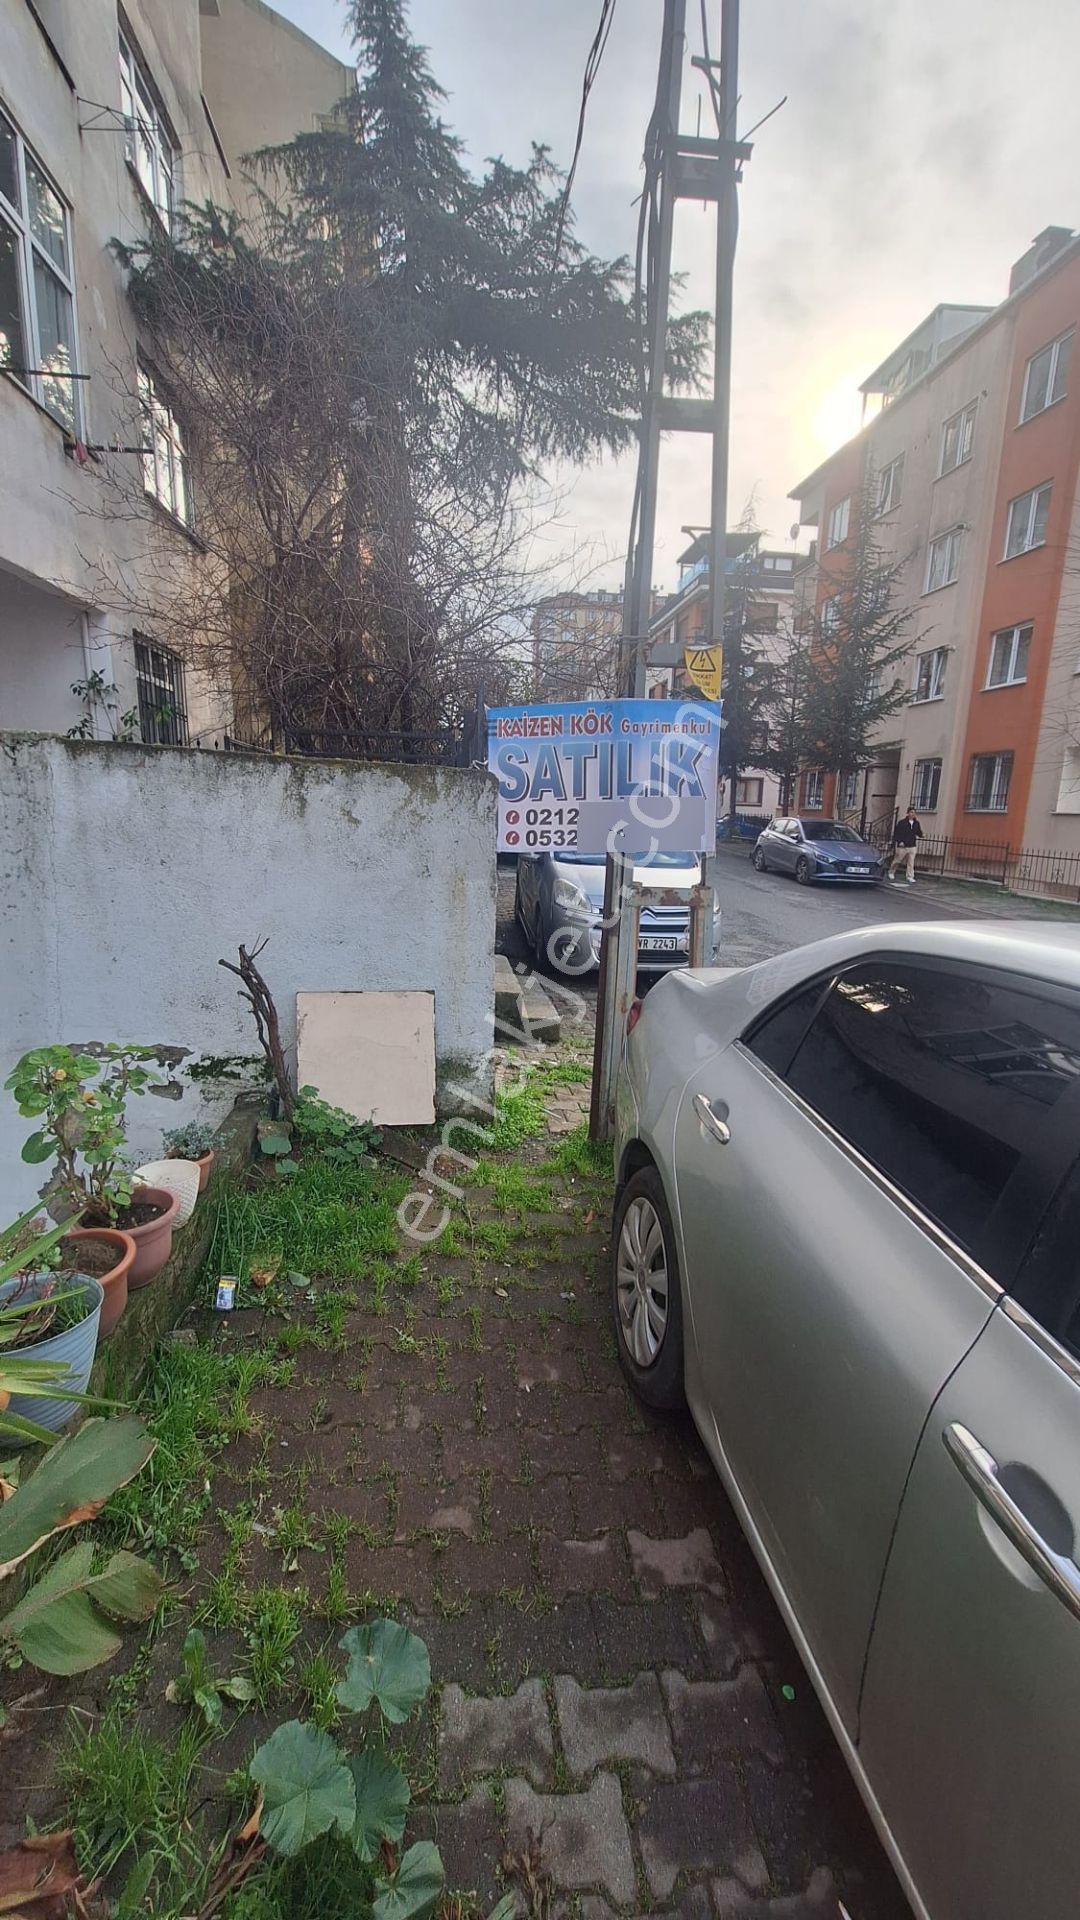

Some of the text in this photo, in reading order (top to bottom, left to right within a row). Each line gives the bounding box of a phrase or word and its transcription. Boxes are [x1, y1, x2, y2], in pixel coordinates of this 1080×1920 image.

[496, 709, 711, 738] KAİZEN KÖK Gayrimenkul
[497, 741, 709, 802] SATILIK
[525, 808, 579, 826] 0212
[525, 829, 578, 846] 0532
[653, 939, 674, 949] 2243
